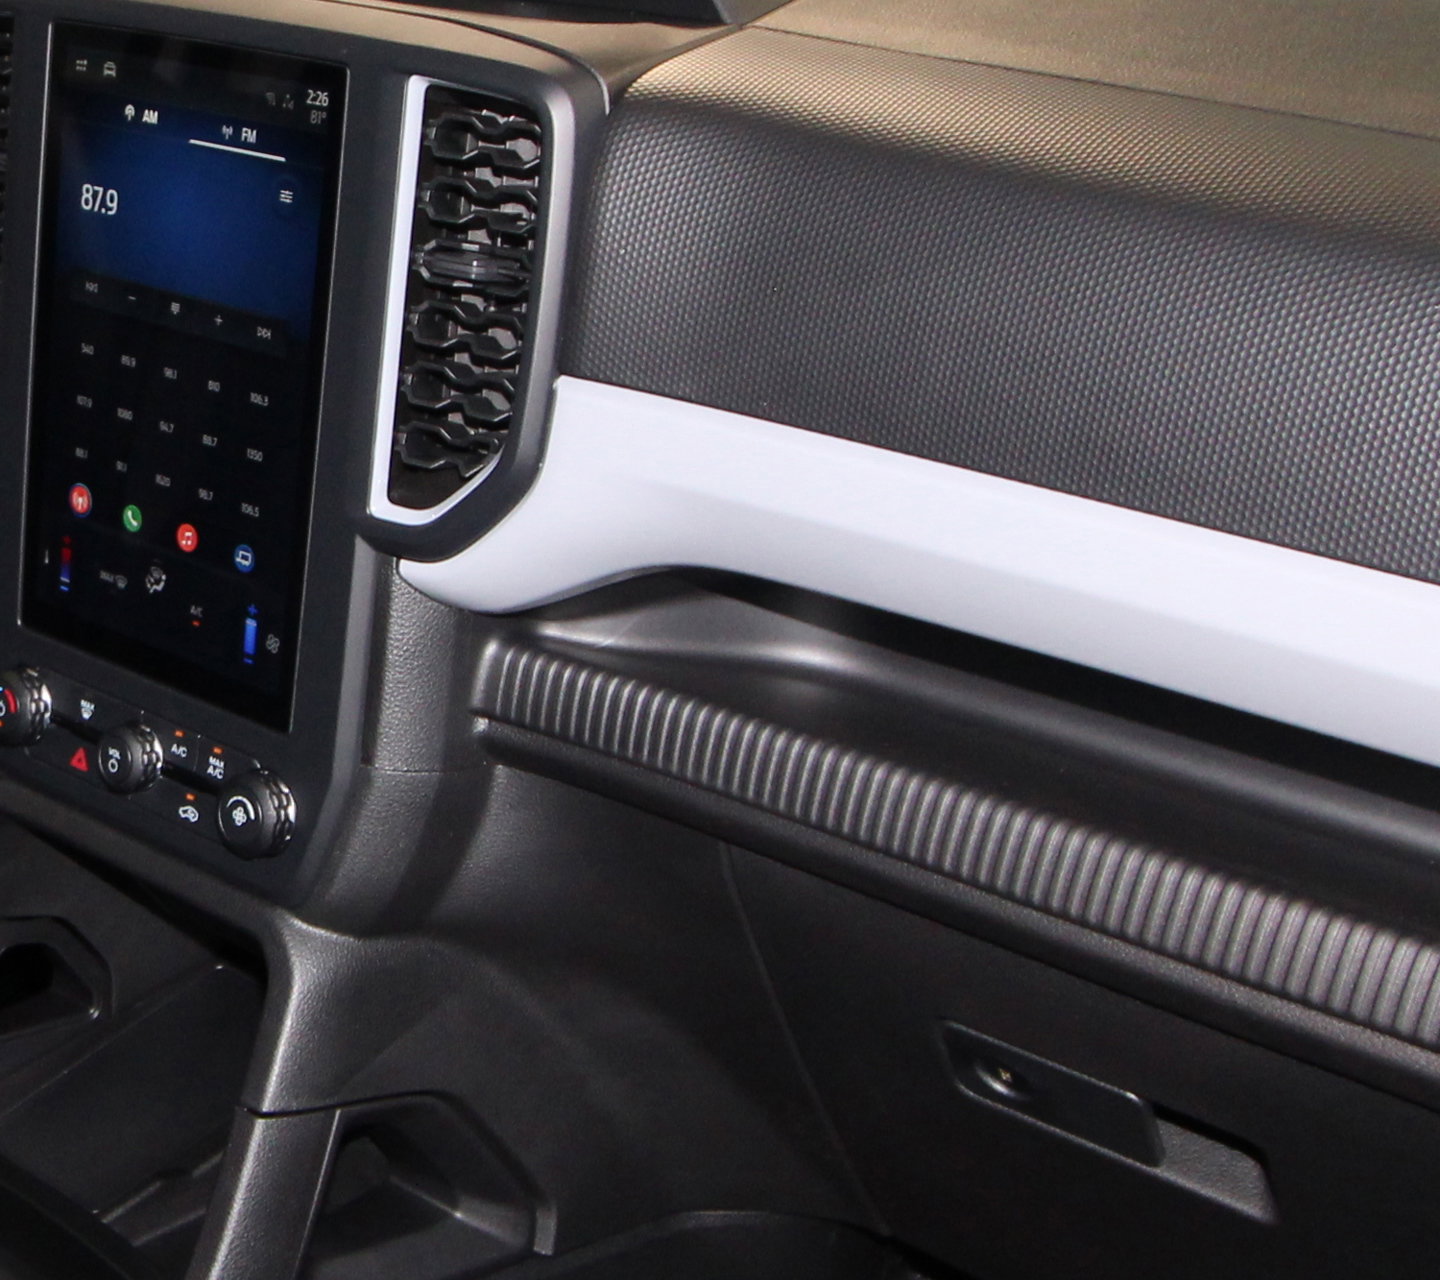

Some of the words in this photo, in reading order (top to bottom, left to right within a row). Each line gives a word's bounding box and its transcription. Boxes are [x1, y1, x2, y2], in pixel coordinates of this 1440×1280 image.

[306, 89, 329, 108] 2:26
[141, 109, 159, 125] AM
[241, 127, 257, 144] FM
[80, 183, 120, 215] 87.9
[80, 699, 95, 712] MAX
[109, 747, 121, 759] VOL
[171, 743, 188, 757] A/C
[209, 756, 225, 769] MAX
[207, 765, 224, 780] A/C
